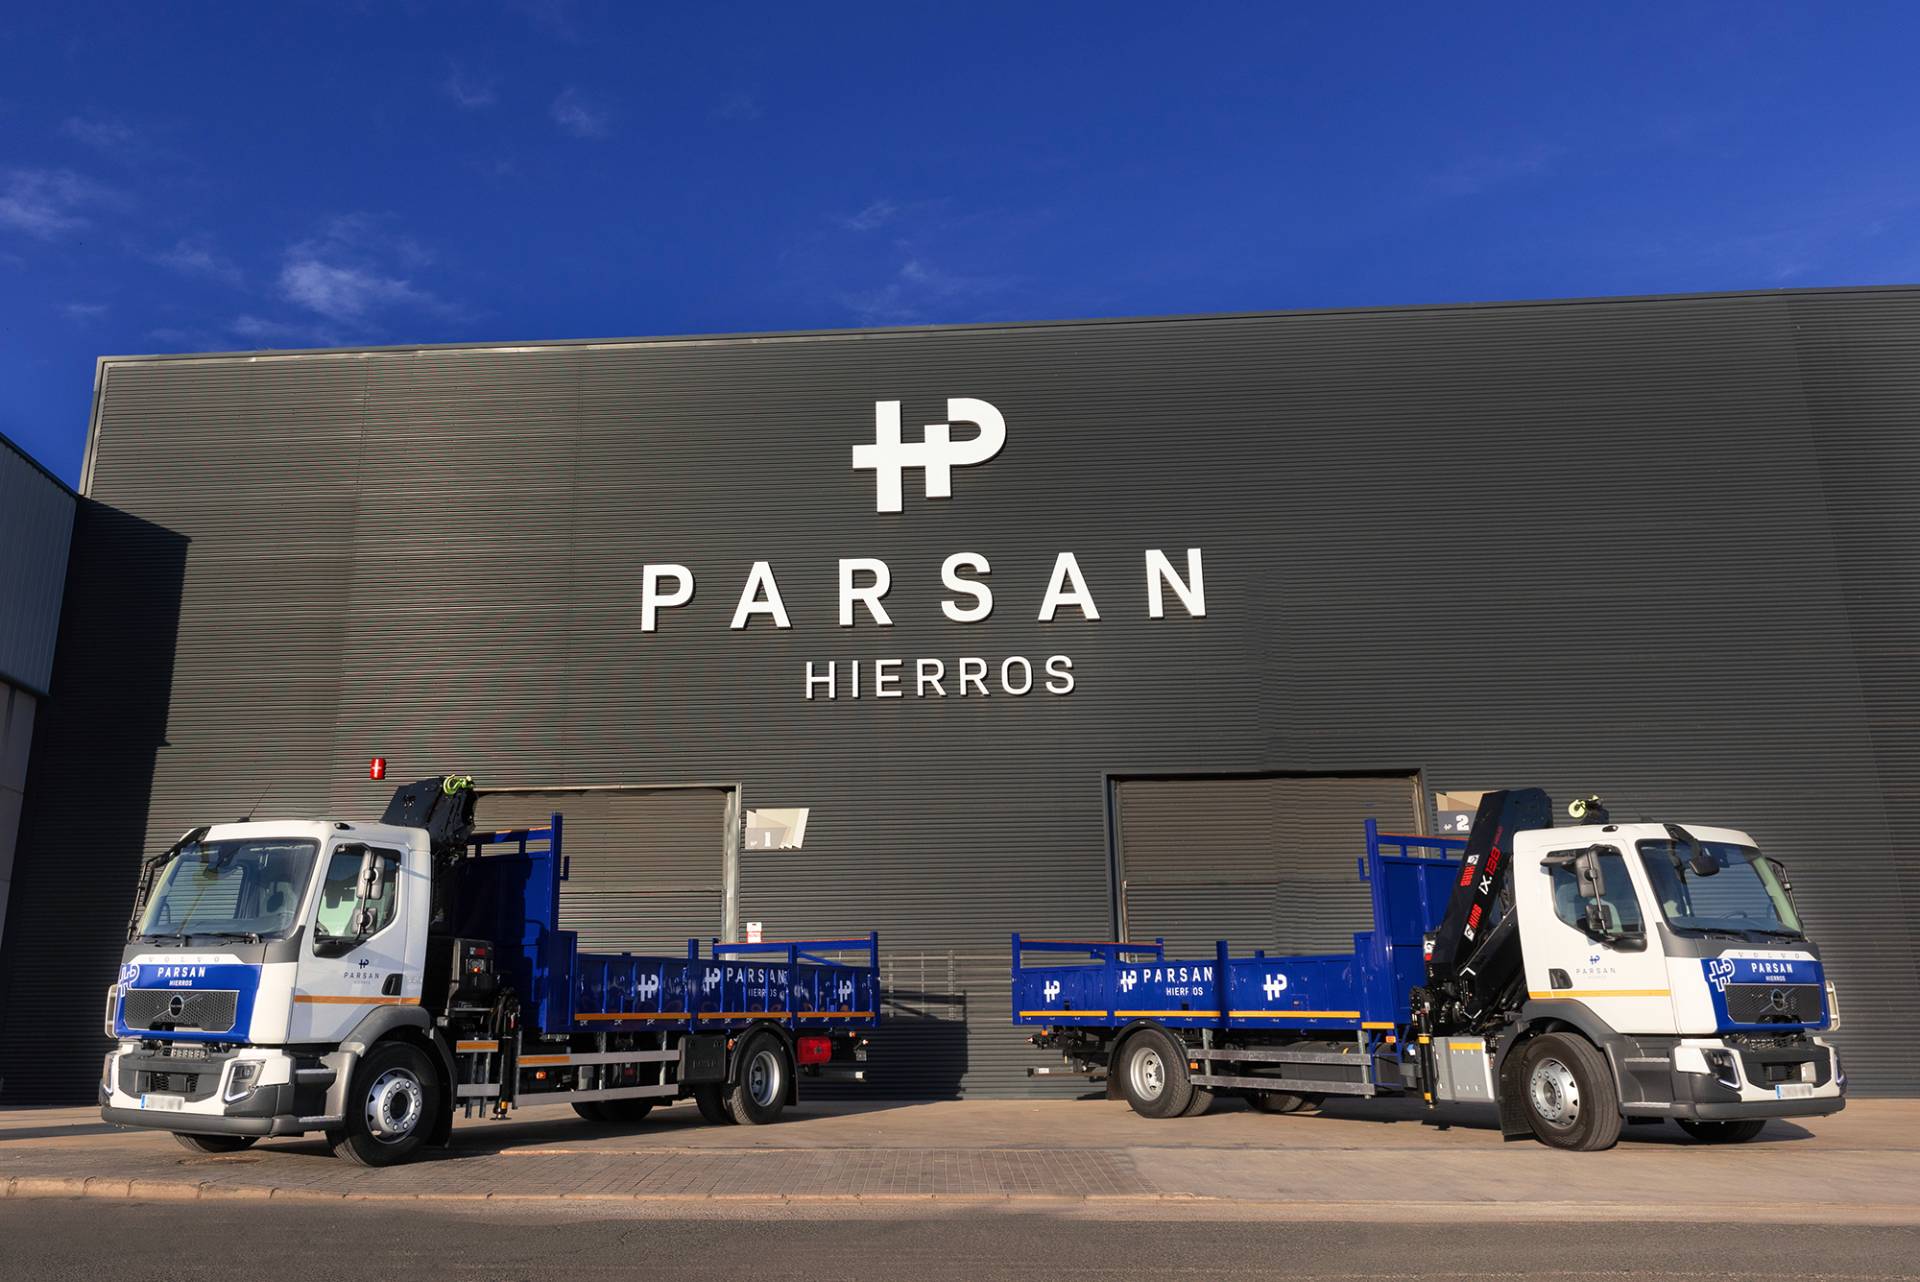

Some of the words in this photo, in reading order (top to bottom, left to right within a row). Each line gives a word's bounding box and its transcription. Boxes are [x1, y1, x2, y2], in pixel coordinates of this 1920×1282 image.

[641, 548, 1207, 632] PARSAN
[805, 655, 1075, 699] HIERROS
[1456, 814, 1470, 831] 2
[1468, 904, 1482, 928] HIAB
[1738, 951, 1800, 959] VOLVO
[157, 966, 207, 978] PARSAN
[726, 967, 785, 985] PARSAN
[1143, 966, 1213, 983] PARSAN
[1751, 962, 1793, 973] PARSAN
